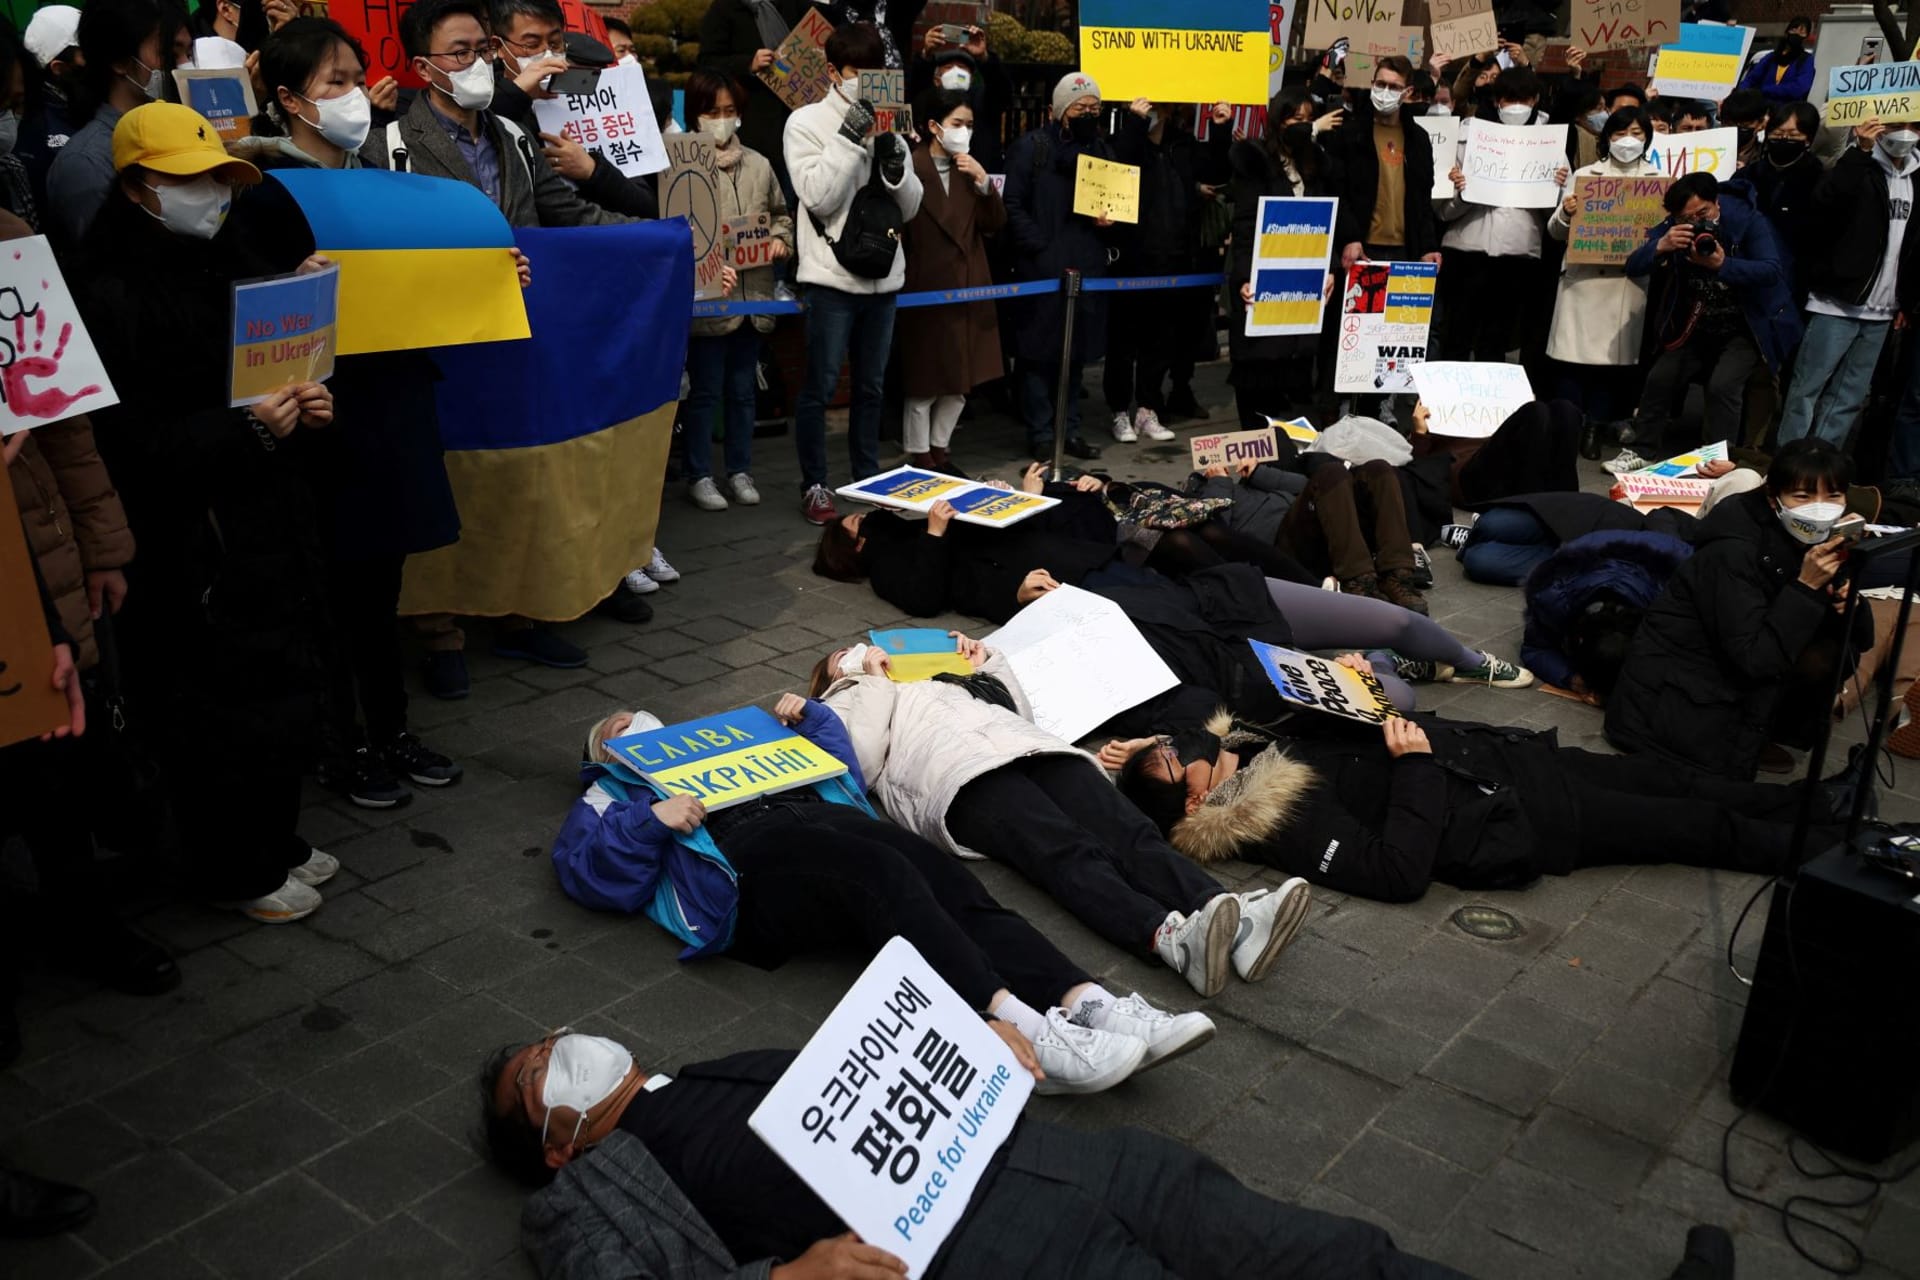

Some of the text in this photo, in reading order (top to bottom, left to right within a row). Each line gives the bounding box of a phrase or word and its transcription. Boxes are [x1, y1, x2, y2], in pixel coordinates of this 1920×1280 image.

[1092, 31, 1243, 52] STAND WITH UKRAINE
[861, 73, 904, 103] PEACE
[1836, 65, 1920, 93] STOP PUTIN
[566, 86, 617, 115] 러시아
[1832, 97, 1910, 120] STOP WAR
[564, 112, 636, 144] 침공 중단
[608, 139, 643, 166] 철수
[1583, 177, 1622, 200] STOP
[1585, 199, 1614, 212] STOP
[1266, 223, 1327, 236] #StandWithUkraine
[698, 242, 724, 286] WAR
[735, 242, 771, 265] OUT
[1259, 291, 1318, 303] #StandWithUkraine
[247, 313, 314, 338] No War
[246, 336, 327, 368] in Ukraine
[1377, 346, 1425, 358] WAR
[1194, 436, 1221, 452] STOP
[1226, 435, 1273, 462] PUTIN
[1279, 663, 1320, 706] Give
[1305, 658, 1361, 719] Peace
[625, 723, 754, 766] СЛАВА
[801, 976, 932, 1144] 우크라이나에
[851, 1027, 978, 1185] 평화를
[894, 1064, 1011, 1241] Peace for Ukraine
